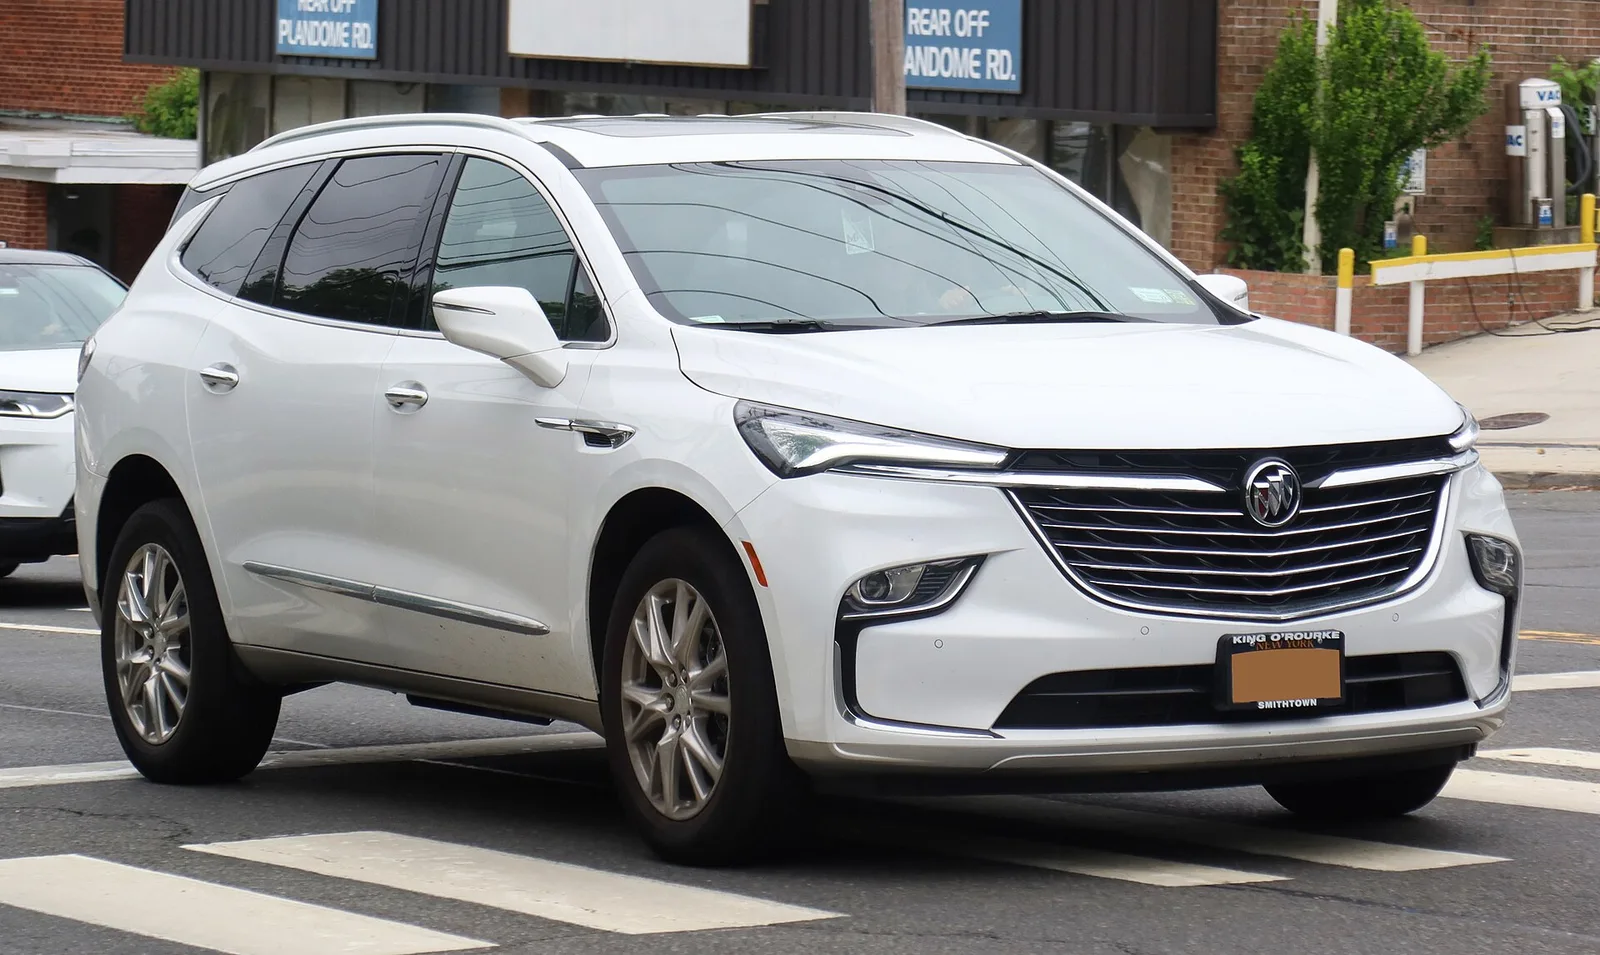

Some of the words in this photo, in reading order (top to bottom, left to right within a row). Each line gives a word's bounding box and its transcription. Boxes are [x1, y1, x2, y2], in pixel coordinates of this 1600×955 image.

[907, 8, 951, 36] REAR
[954, 9, 990, 37] OFF
[278, 19, 350, 48] PLANDOME
[352, 22, 374, 49] RD.
[903, 45, 982, 79] ANDOME
[986, 49, 1016, 81] RD.
[1505, 134, 1523, 147] AC
[1233, 634, 1267, 645] KING
[1270, 631, 1340, 643] O'ROURKE
[1256, 641, 1283, 650] NEW
[1286, 639, 1315, 649] YORK
[1258, 698, 1318, 709] SMITHTOWN
